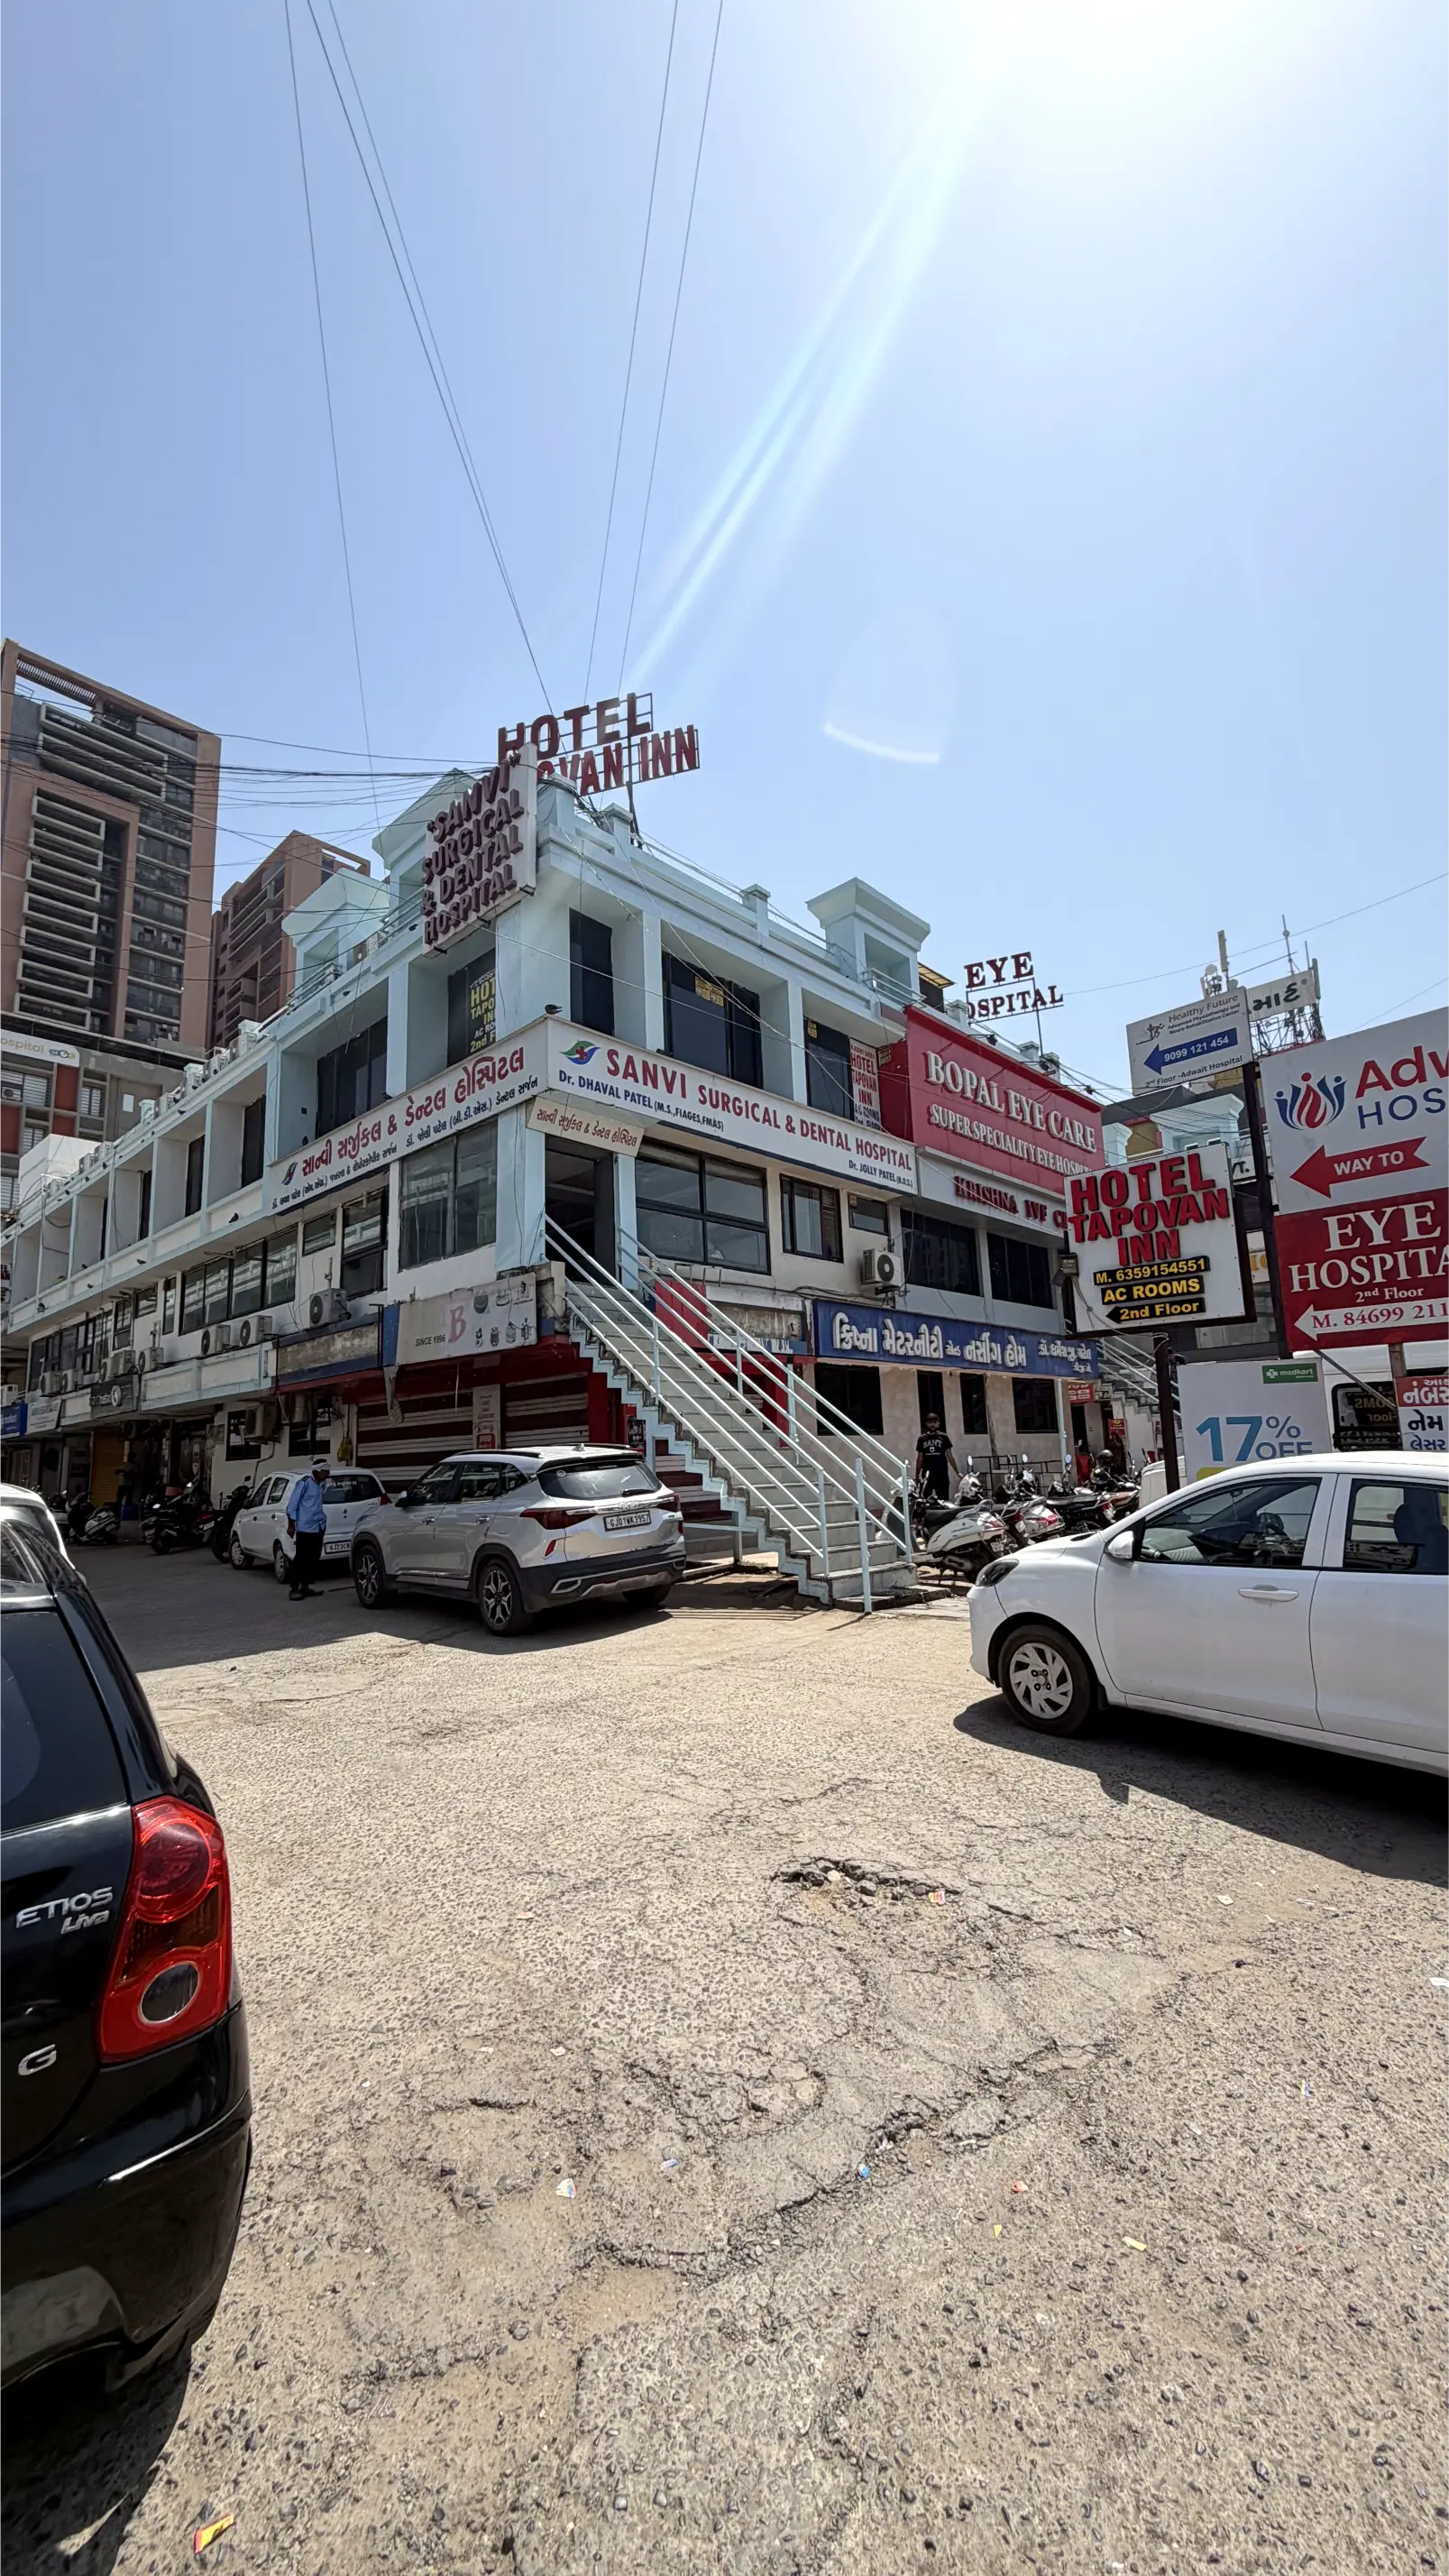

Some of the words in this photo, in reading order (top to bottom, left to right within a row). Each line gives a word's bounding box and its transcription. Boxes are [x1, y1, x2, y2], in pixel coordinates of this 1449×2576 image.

[498, 692, 651, 765] HOTEL
[639, 724, 698, 782] INN
[422, 788, 524, 885] SURGICAL
[422, 889, 436, 917] &
[440, 824, 523, 905] DENTAL
[425, 864, 517, 944] HOSPITAL
[964, 952, 1034, 989] EYE
[1169, 1006, 1204, 1023] Healthy
[1206, 995, 1239, 1010] Future
[1164, 1048, 1188, 1062] 9099
[1190, 1042, 1207, 1054] 121
[1211, 1035, 1229, 1047] 454
[851, 1053, 876, 1075] HOTEL
[1157, 1074, 1176, 1085] Floor
[1209, 1055, 1243, 1071] Hospital
[559, 1070, 574, 1085] Dr.
[579, 1076, 621, 1099] DHAVAL
[624, 1090, 653, 1109] PATEL
[851, 1070, 876, 1092] TAPOVAN
[388, 1115, 397, 1136] &
[405, 1088, 445, 1127] ડેન્ટલ
[607, 1048, 686, 1099] SANVI
[698, 1084, 781, 1129] SURGICAL
[785, 1115, 796, 1135] &
[800, 1118, 851, 1152] DENTAL
[856, 1136, 912, 1171] HOSPITAL
[858, 1088, 872, 1107] INN
[924, 1050, 1004, 1114] BOPAL
[1007, 1089, 1046, 1131] EYE
[1049, 1110, 1097, 1155] CARE
[1358, 1088, 1445, 1129] HOS
[859, 1163, 877, 1177] JOLLY
[878, 1168, 895, 1182] PATEL
[1037, 1146, 1055, 1170] EYE
[1333, 1155, 1373, 1177] WAY
[1378, 1150, 1404, 1167] TO
[954, 1175, 1019, 1214] KRISHNA
[1070, 1153, 1216, 1215] HOTEL
[1068, 1187, 1231, 1244] TAPOVAN
[1322, 1200, 1441, 1253] EYE
[1117, 1228, 1181, 1266] INN
[1096, 1272, 1112, 1284] M.
[1116, 1257, 1206, 1282] 6359154551
[1104, 1288, 1126, 1303] AC
[1133, 1278, 1200, 1298] ROOMS
[1355, 1288, 1380, 1302] 2nd
[1383, 1287, 1424, 1300] Floor
[1120, 1306, 1150, 1320] 2nd
[1155, 1301, 1199, 1316] Floor
[1312, 1314, 1337, 1329] M.
[1344, 1307, 1404, 1326] 84699
[415, 1337, 432, 1347] SINCE
[433, 1335, 446, 1345] 1996
[1004, 1335, 1027, 1367] હોમ
[1408, 1409, 1444, 1431] નેમ
[1256, 1441, 1312, 1460] OFF
[1410, 1435, 1446, 1450] લેસર
[16, 1886, 113, 1928] ETIOS
[60, 1909, 110, 1935] Liva
[18, 2044, 57, 2075] G
